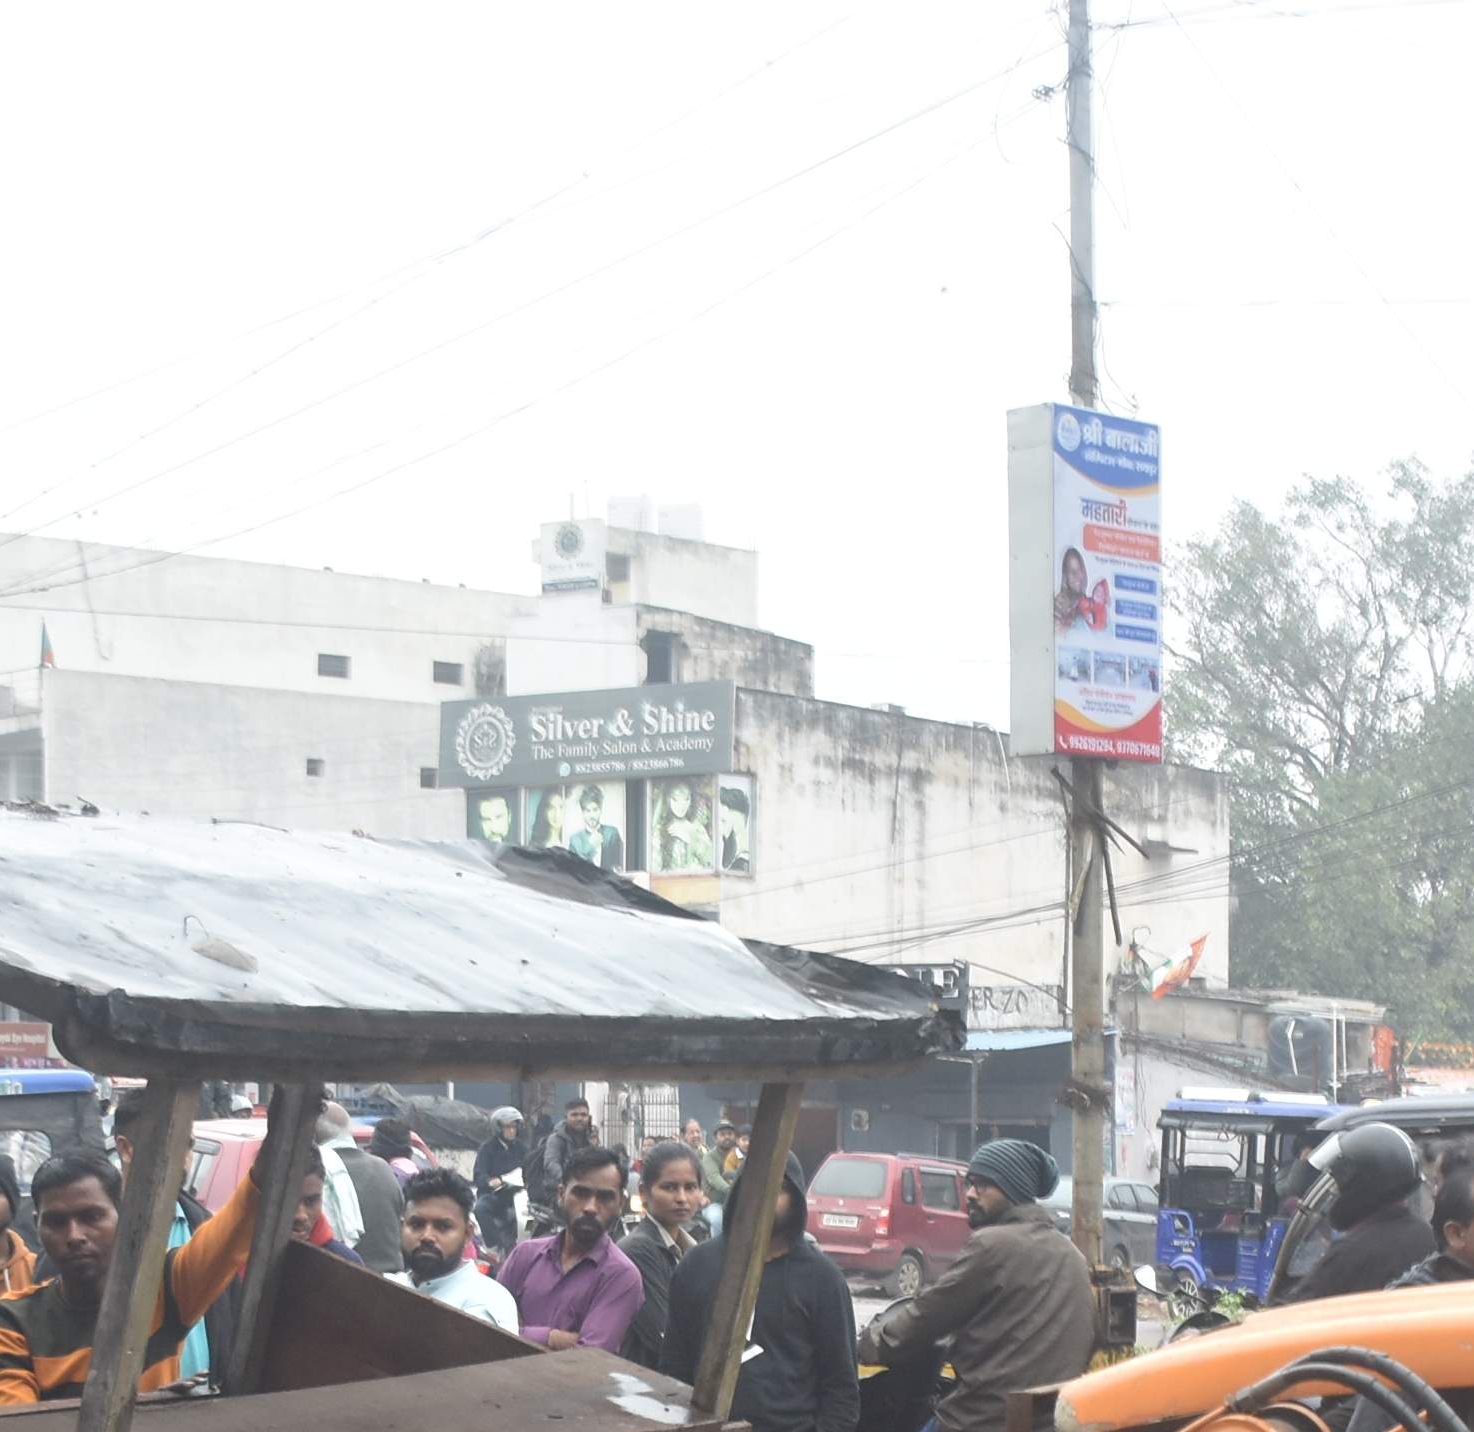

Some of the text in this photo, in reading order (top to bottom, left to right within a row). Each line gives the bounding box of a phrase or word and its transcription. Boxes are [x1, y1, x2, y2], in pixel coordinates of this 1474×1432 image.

[1080, 498, 1127, 528] महतारी
[531, 703, 716, 743] Silver & Shine
[531, 735, 715, 761] The Family Salon & Academy
